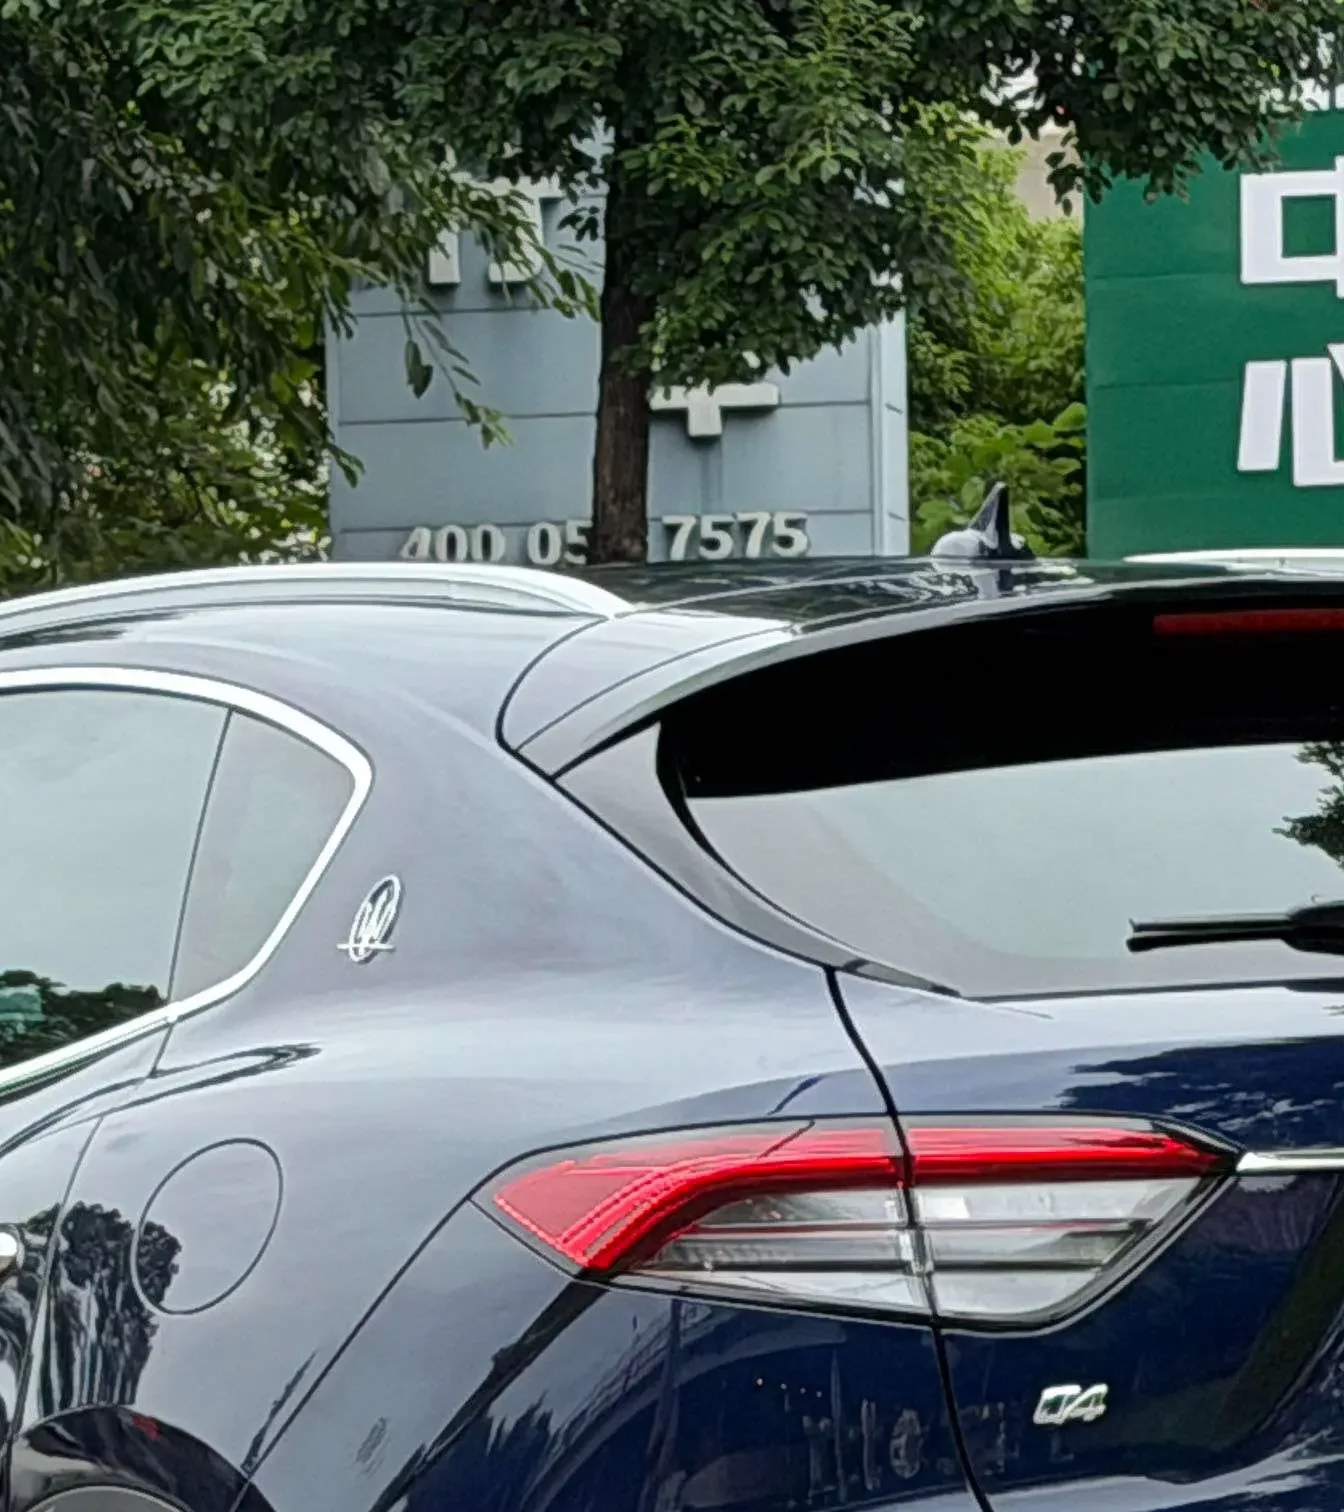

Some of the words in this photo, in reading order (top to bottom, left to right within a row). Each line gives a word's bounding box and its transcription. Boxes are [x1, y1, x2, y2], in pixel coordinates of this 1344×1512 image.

[400, 522, 506, 564] 400
[527, 520, 595, 565] 05
[662, 511, 809, 561] 7575
